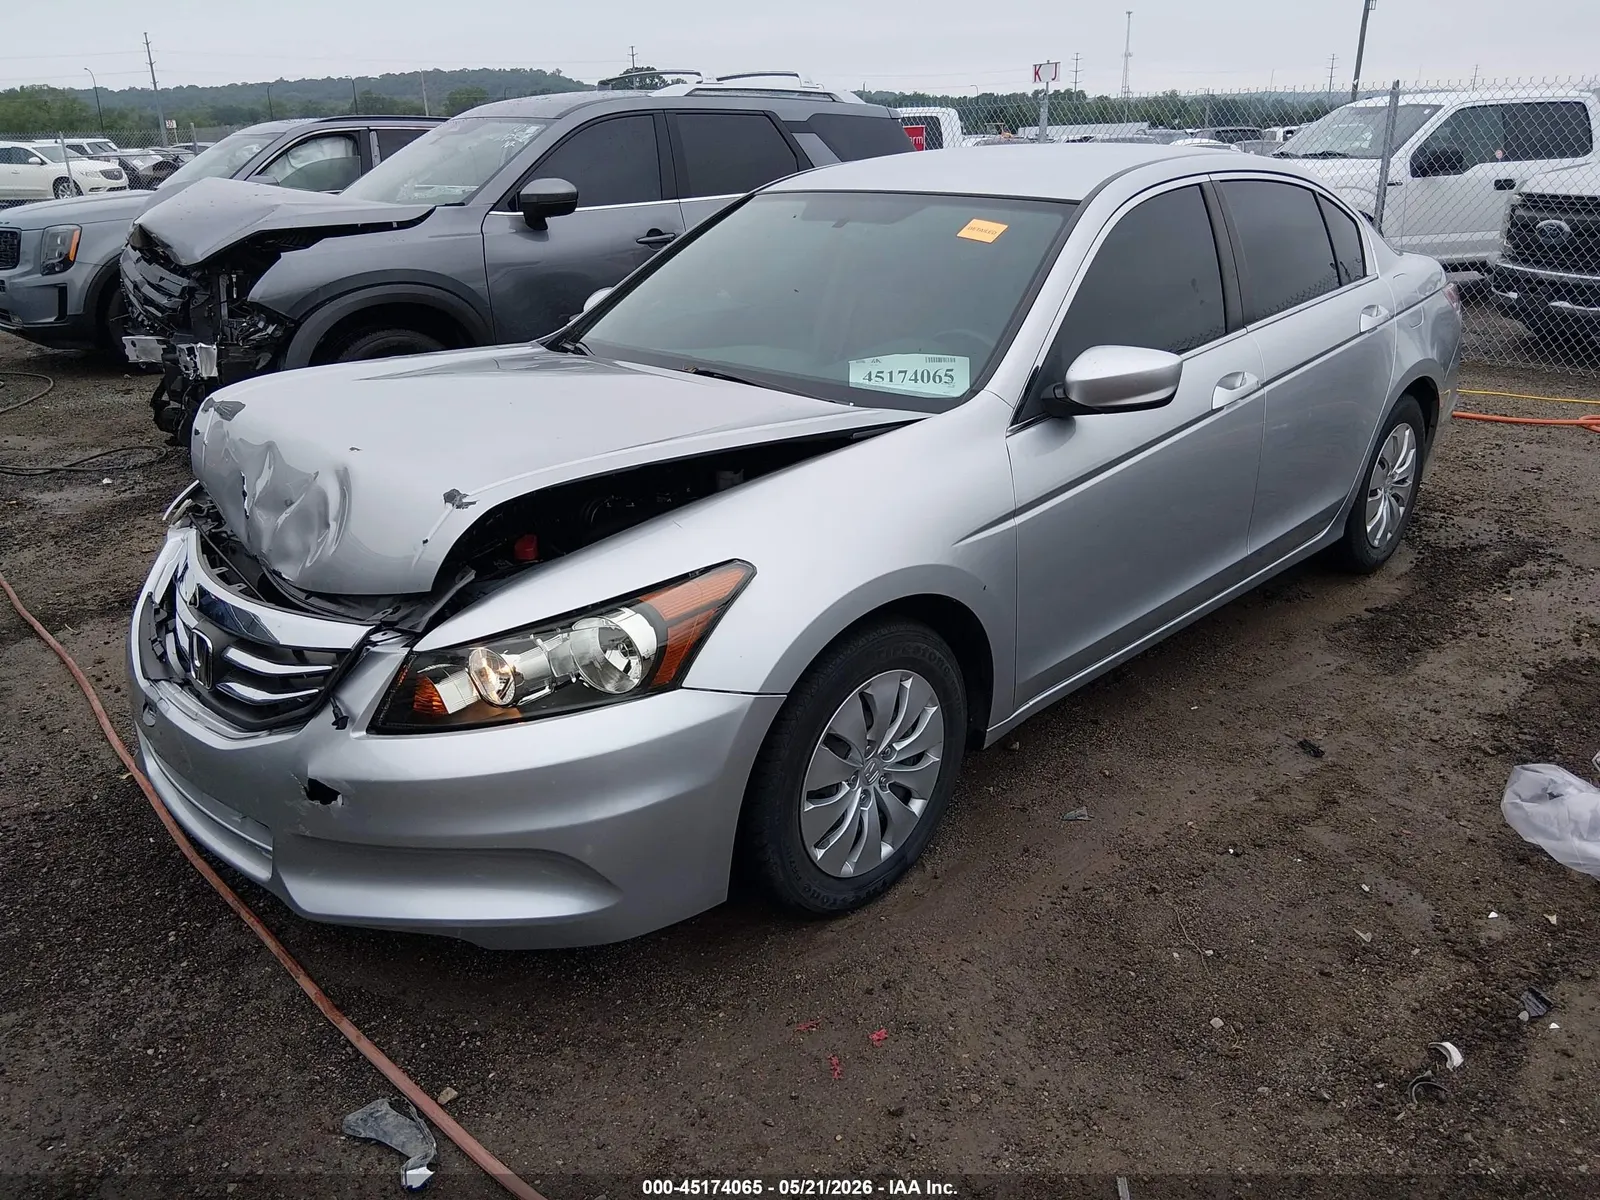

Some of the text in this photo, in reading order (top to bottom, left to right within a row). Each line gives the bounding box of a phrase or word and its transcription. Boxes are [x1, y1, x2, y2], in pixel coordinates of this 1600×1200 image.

[1034, 63, 1057, 82] K J
[862, 368, 955, 385] 45174065
